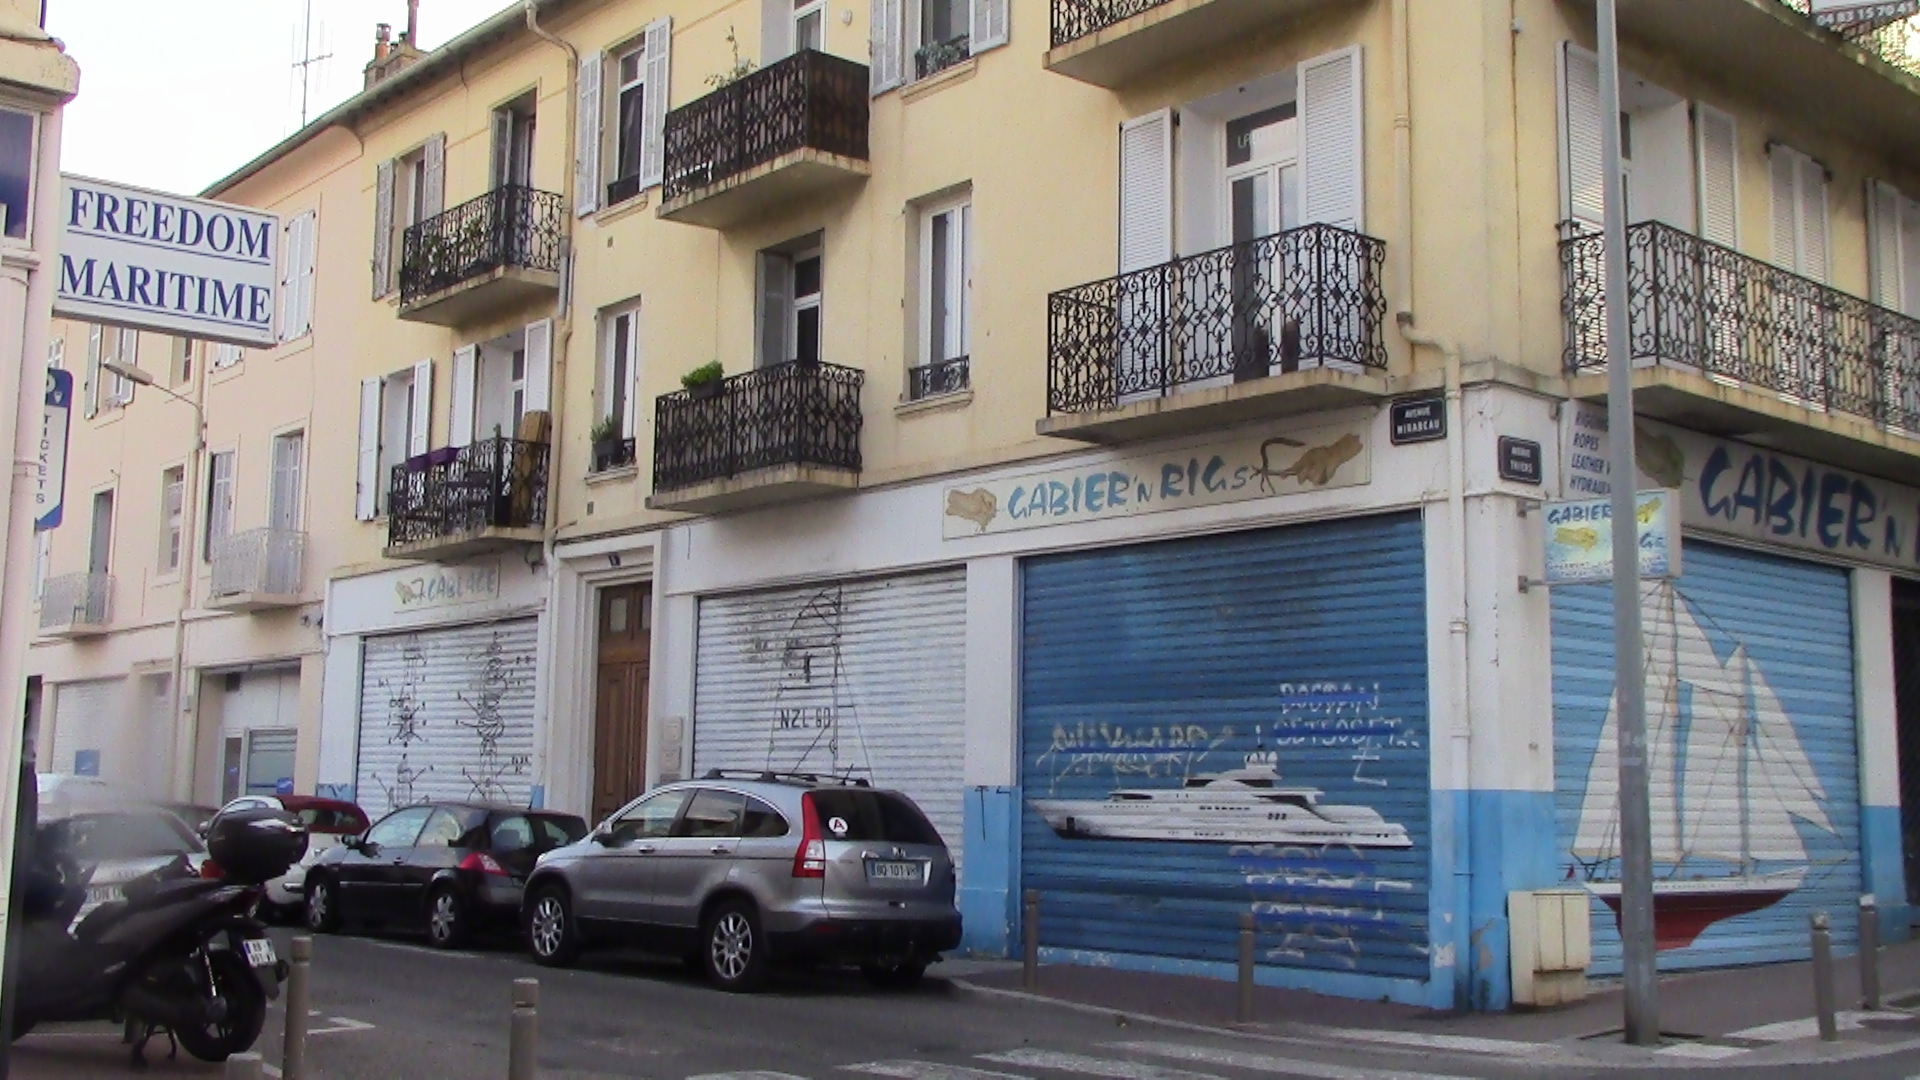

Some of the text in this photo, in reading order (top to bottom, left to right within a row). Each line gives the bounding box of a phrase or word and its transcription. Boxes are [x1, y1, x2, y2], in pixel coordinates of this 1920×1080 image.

[68, 186, 272, 260] FREEDOM
[57, 253, 272, 325] MARITIME
[36, 415, 51, 504] TICKETS
[1573, 432, 1599, 451] ROPES
[833, 818, 845, 830] A
